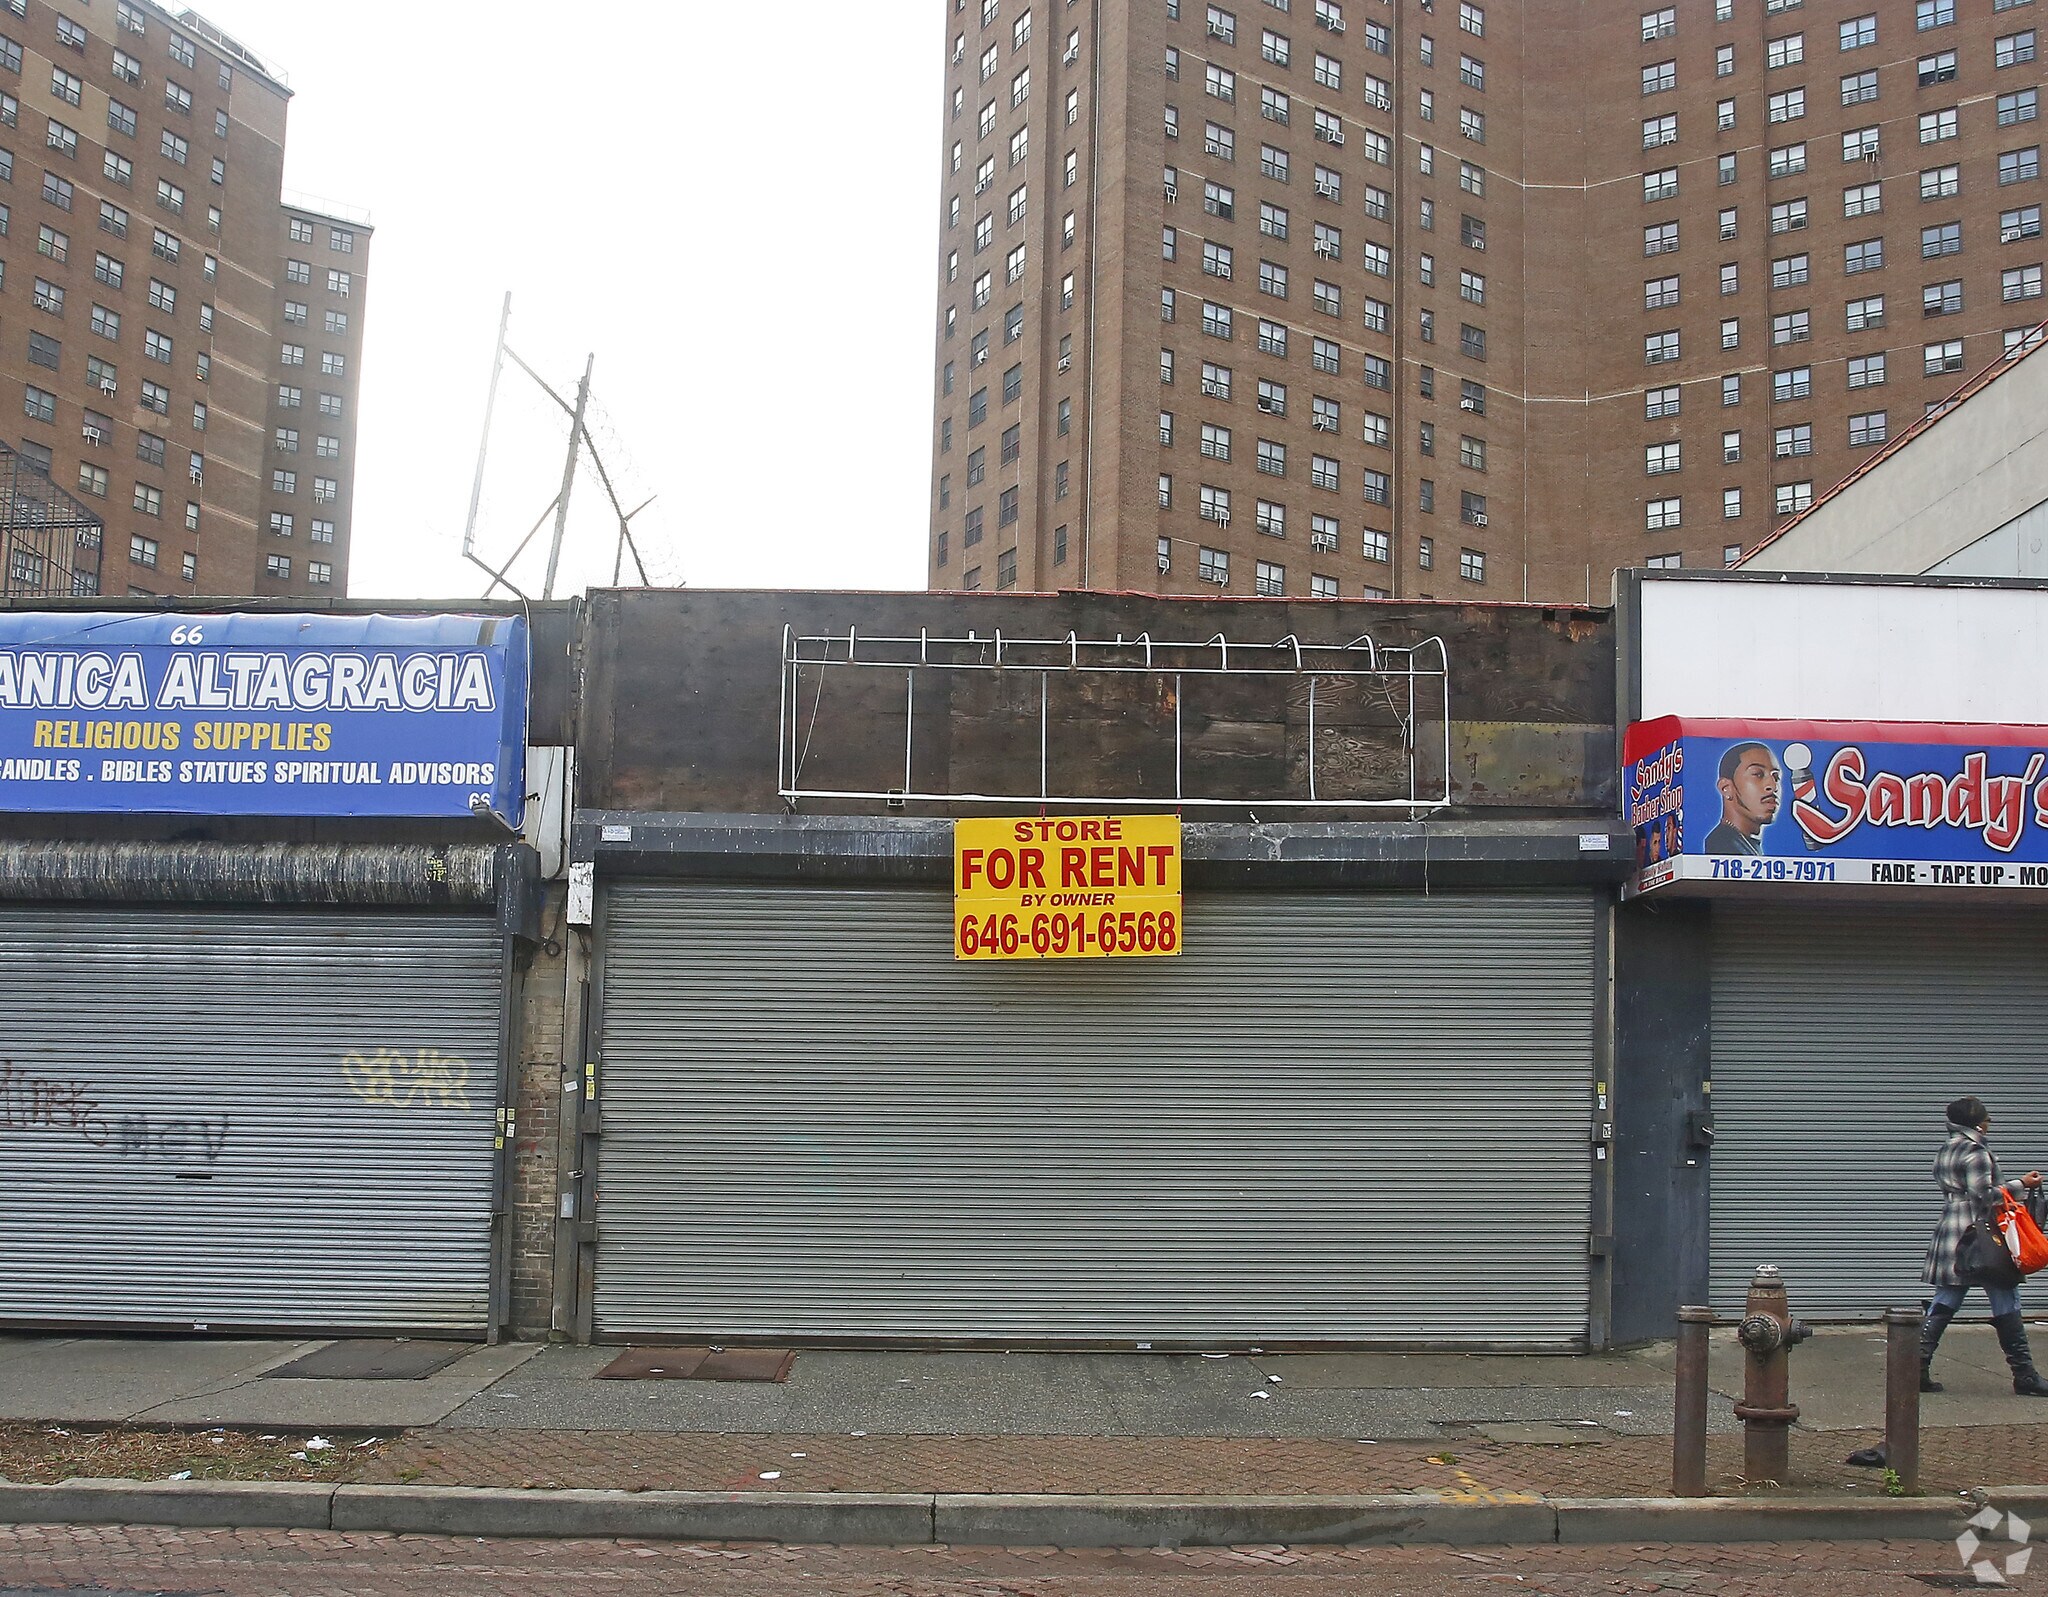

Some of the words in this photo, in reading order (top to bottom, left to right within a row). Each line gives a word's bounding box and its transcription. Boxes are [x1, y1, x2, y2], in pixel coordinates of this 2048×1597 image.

[170, 624, 204, 646] 66
[155, 652, 496, 712] ALTAGRACIA
[33, 720, 181, 750] RELIGIOUS
[193, 721, 332, 751] SUPPLIES
[101, 760, 173, 782] BIBLES
[179, 761, 268, 783] STATUES
[274, 761, 382, 784] SPIRITUAL
[388, 762, 495, 785] ADVISORS
[1631, 740, 1683, 801] Sandy's
[1631, 794, 1660, 829] Barber
[1660, 784, 1683, 815] Shop
[1014, 820, 1122, 842] STORE
[962, 848, 1046, 890] FOR
[1061, 846, 1174, 888] RENT
[1710, 858, 1836, 881] 718-219-7971
[1871, 863, 1916, 883] FADE
[1930, 864, 1976, 884] TAPE
[1979, 866, 2004, 885] UP
[2019, 867, 2048, 886] MO
[1020, 894, 1047, 907] BY
[1050, 893, 1116, 906] OWNER
[960, 911, 1176, 955] 646-691-6568
